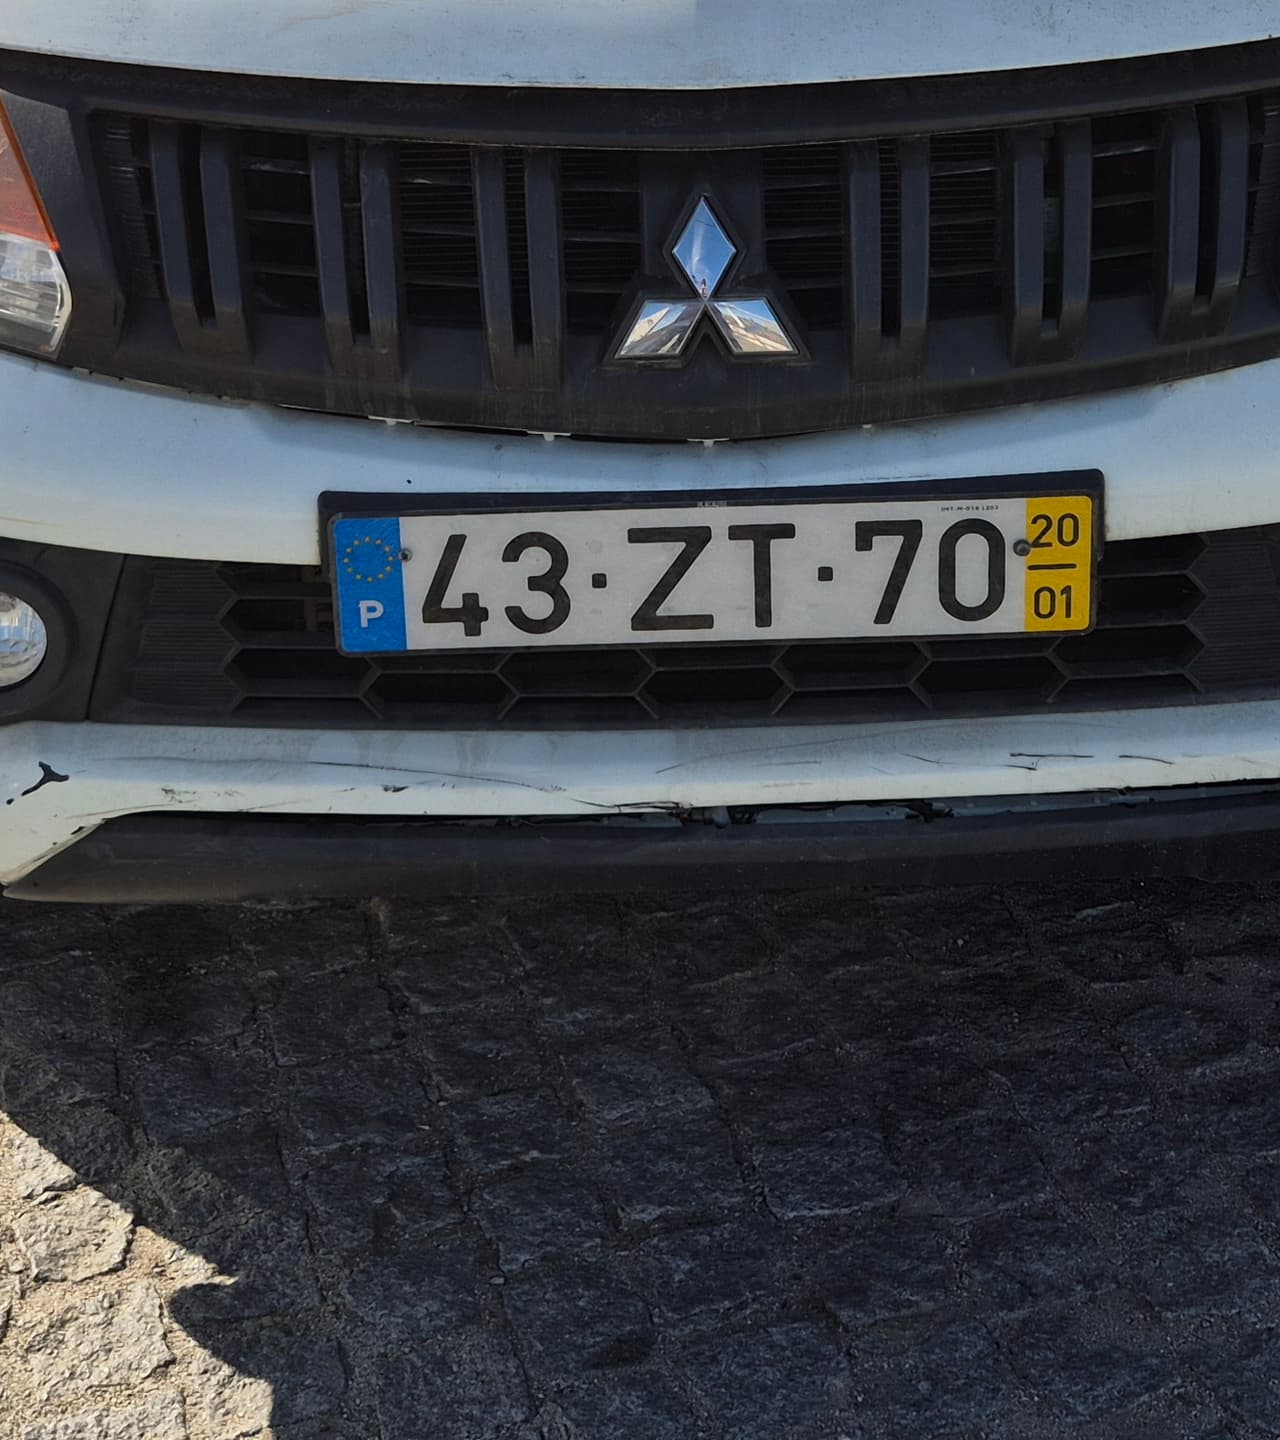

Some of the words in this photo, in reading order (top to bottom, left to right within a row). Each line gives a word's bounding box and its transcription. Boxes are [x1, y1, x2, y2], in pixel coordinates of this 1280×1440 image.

[1030, 513, 1080, 548] 20
[359, 601, 384, 629] P
[1034, 585, 1073, 620] 01
